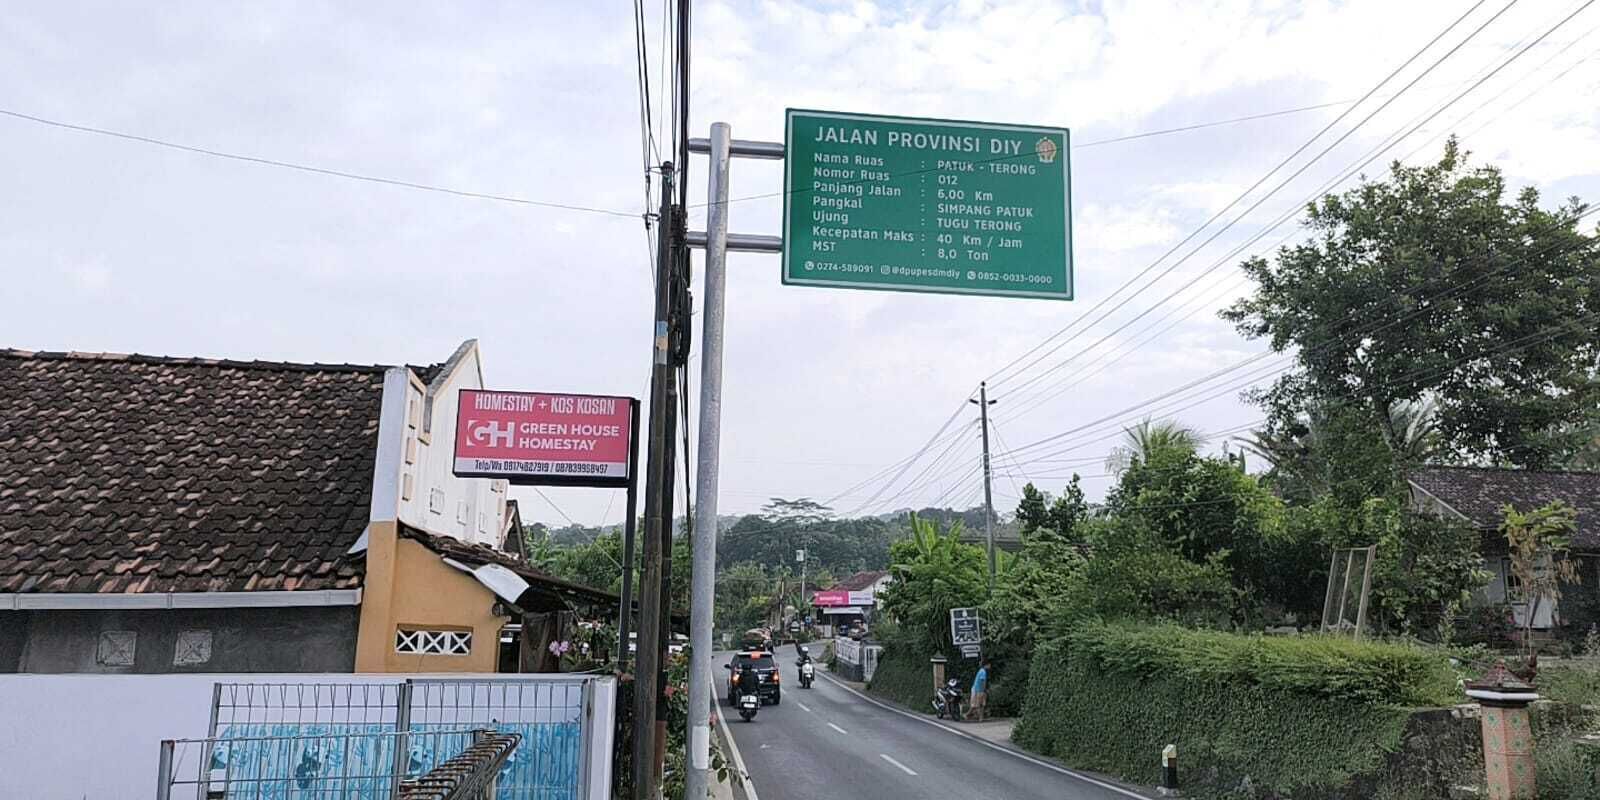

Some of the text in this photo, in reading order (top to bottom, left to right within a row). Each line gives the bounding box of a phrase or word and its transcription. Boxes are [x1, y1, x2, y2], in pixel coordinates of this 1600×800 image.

[815, 126, 1022, 156] JALAN PROVINSI DIY
[814, 152, 850, 165] Nama
[855, 155, 884, 167] Ruas
[937, 160, 974, 172] PATUK
[989, 163, 1036, 175] TERONG
[814, 167, 855, 179] Nomor
[861, 170, 890, 182] Ruas
[938, 175, 958, 186] 012
[814, 181, 863, 198] Panjang
[868, 184, 901, 197] Jalan
[975, 190, 993, 201] Km
[813, 196, 862, 212] Pangkal
[937, 204, 991, 216] SIMPANG
[997, 206, 1033, 218] PATUK
[813, 211, 849, 225] Ujung
[937, 218, 969, 230] TUGU
[974, 220, 1021, 232] TERONG
[813, 226, 878, 241] Kecepatan
[884, 229, 914, 242] Maks
[937, 234, 953, 245] 40
[963, 235, 982, 246] Km
[998, 237, 1022, 249] Jam
[813, 240, 837, 252] MST
[968, 250, 989, 262] Ton
[475, 394, 535, 412] HOMESTAY
[551, 397, 573, 414] KOS
[576, 399, 615, 415] KOSAN
[466, 420, 515, 448] GH
[520, 422, 619, 436] GREEN HOUSE
[519, 438, 596, 450] HOMESTAY
